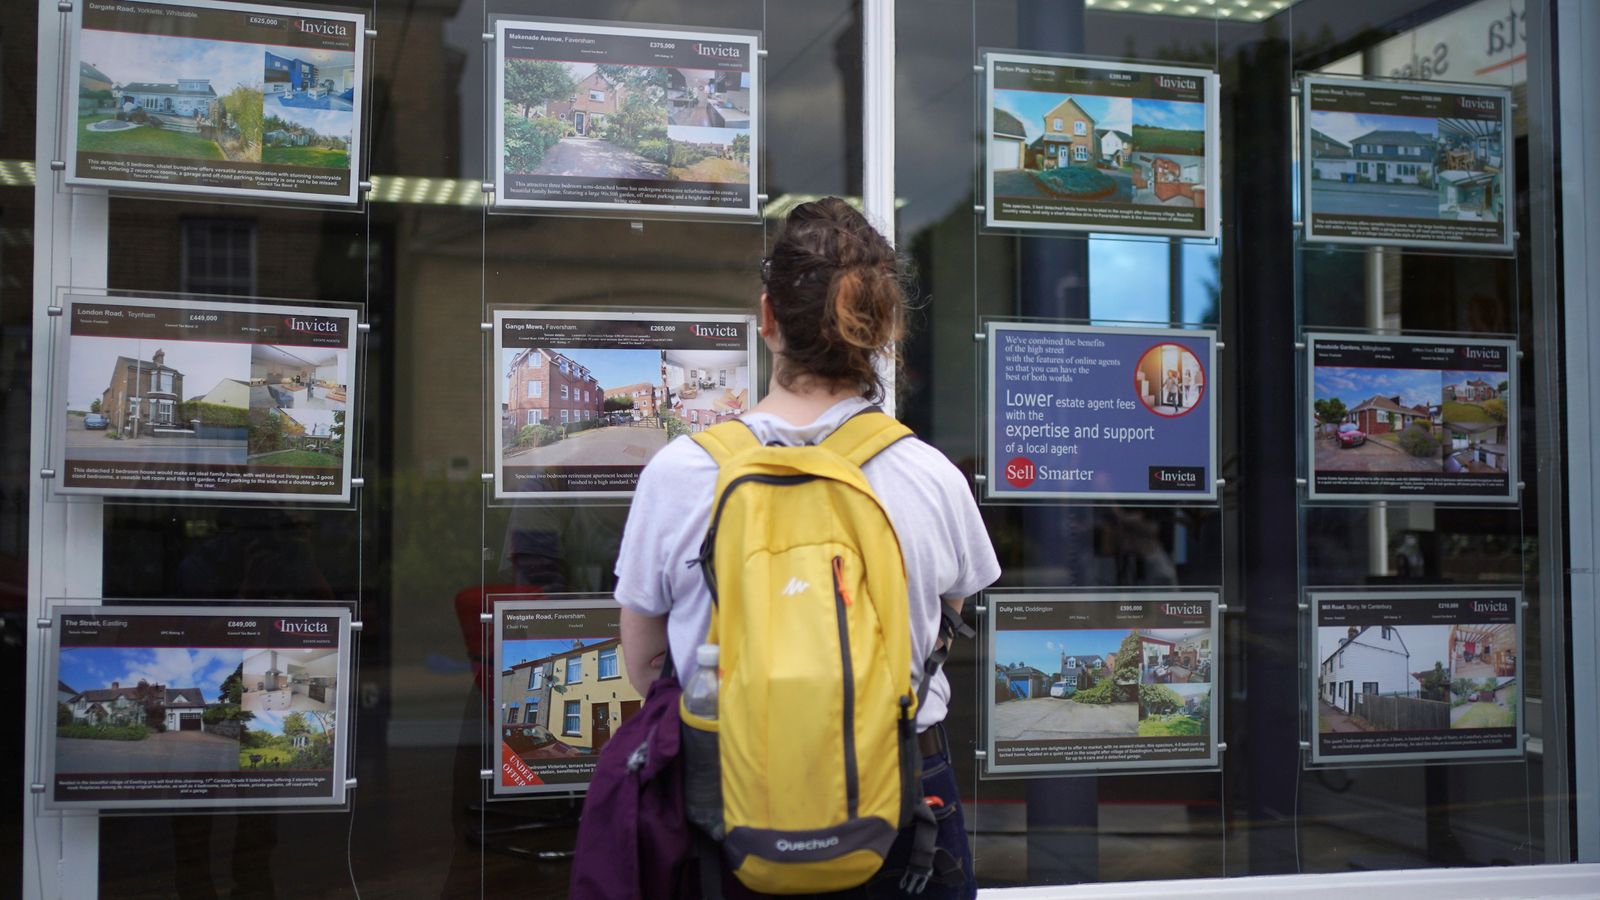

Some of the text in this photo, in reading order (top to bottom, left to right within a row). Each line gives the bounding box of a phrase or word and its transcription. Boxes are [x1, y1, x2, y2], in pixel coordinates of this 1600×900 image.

[250, 16, 278, 25] £625,000
[300, 20, 346, 36] Invicta
[698, 44, 740, 57] Invicta
[1160, 76, 1196, 88] Invicta
[1461, 97, 1495, 109] Invicta
[105, 310, 124, 319] Road,
[128, 311, 156, 320] Teynham
[291, 318, 337, 332] Invicta
[505, 323, 524, 331] Gange
[526, 323, 544, 331] Mews,
[696, 324, 738, 336] Invicta
[1028, 336, 1063, 344] combined
[1078, 338, 1105, 346] benefits
[1028, 346, 1043, 354] high
[1466, 347, 1500, 359] Invicta
[1099, 358, 1120, 366] agents
[1006, 390, 1136, 410] Lower estate agent fees
[1006, 409, 1044, 421] with the
[1006, 422, 1155, 442] expertise and support
[1006, 442, 1015, 453] of
[1026, 443, 1048, 454] local
[1051, 444, 1078, 456] agent
[1007, 465, 1094, 480] Sell Smarter
[1161, 470, 1196, 481] Invicta
[1166, 603, 1202, 615] Invicta
[1474, 601, 1507, 612] Invicta
[281, 619, 328, 632] Invicta
[510, 755, 534, 781] UNDER
[503, 763, 526, 787] OFFER
[776, 836, 839, 852] Quechua
